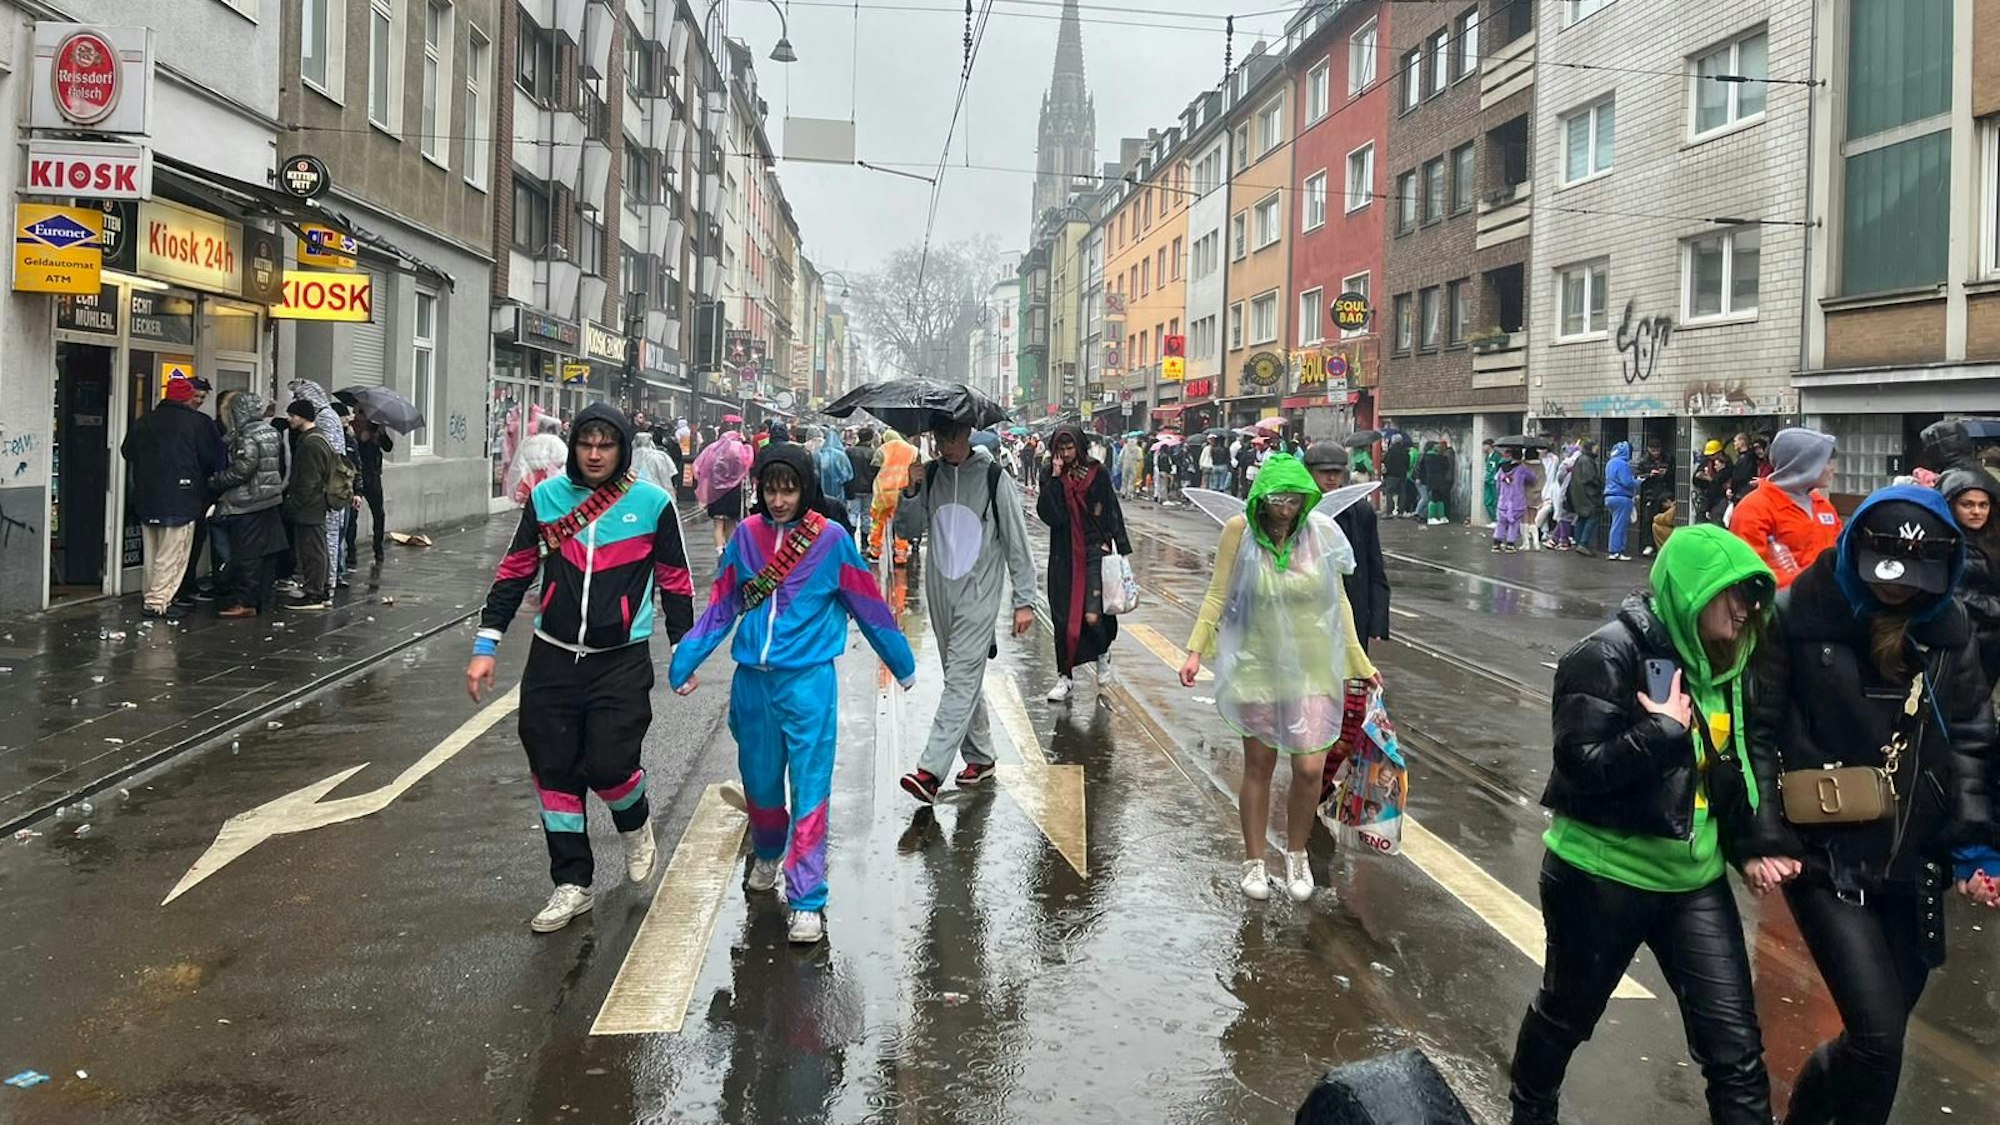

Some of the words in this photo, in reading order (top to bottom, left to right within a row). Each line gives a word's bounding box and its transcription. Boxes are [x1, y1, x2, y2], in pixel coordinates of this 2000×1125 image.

[59, 69, 113, 84] Reissdorf
[30, 160, 138, 192] KIOSK
[292, 180, 311, 190] FETT
[35, 224, 87, 239] Euronet
[149, 220, 199, 266] Kiosk
[204, 237, 234, 274] 24h
[24, 257, 95, 270] Geldautomat
[45, 274, 72, 284] ATM
[132, 296, 153, 315] ECHT
[1335, 300, 1368, 312] SOUL
[1339, 312, 1364, 324] BAR
[1300, 355, 1325, 385] SOUL
